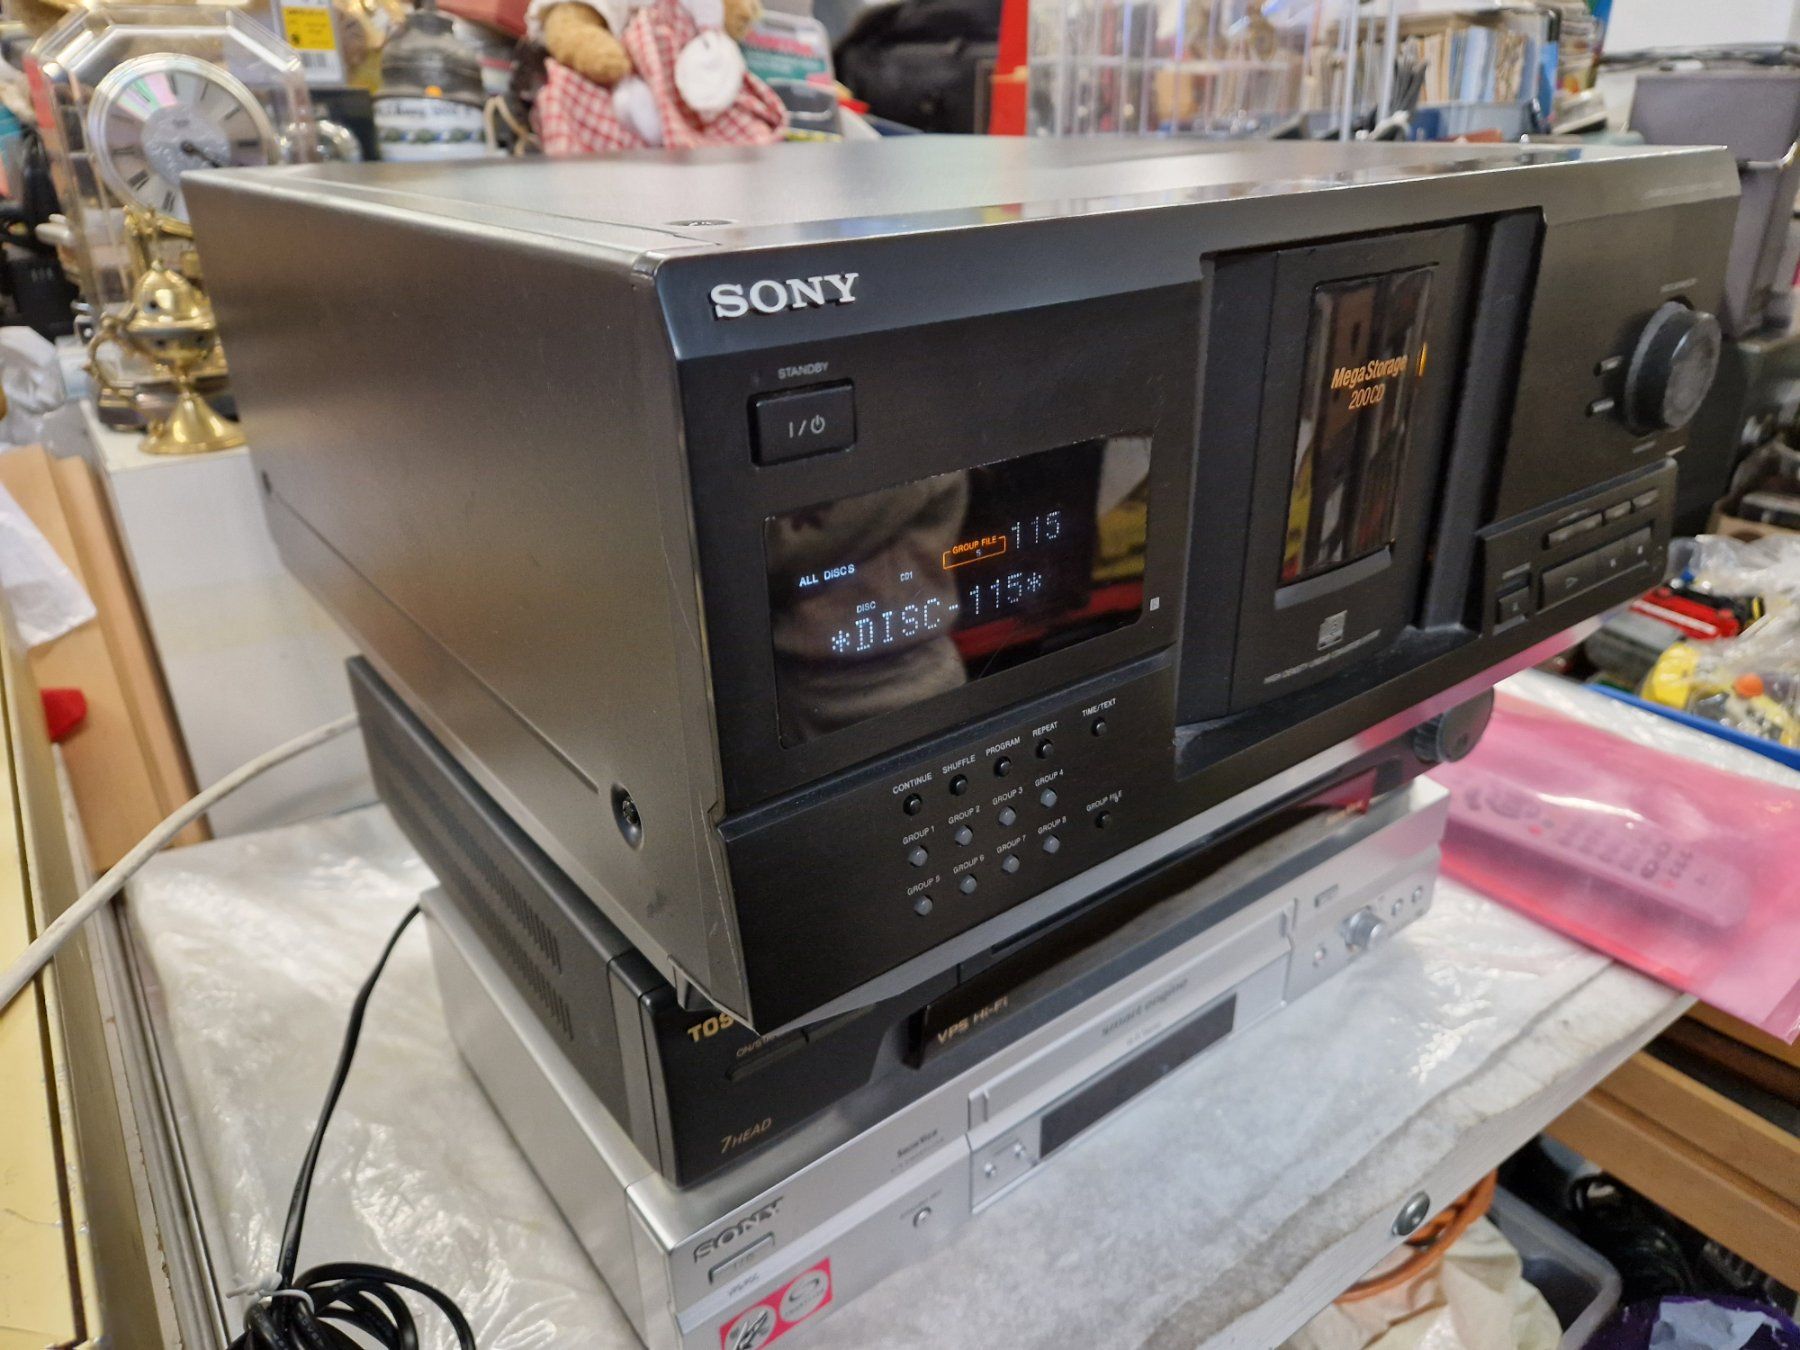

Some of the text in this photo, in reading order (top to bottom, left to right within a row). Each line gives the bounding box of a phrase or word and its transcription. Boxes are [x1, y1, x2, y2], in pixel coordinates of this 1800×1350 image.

[710, 272, 860, 319] SONY
[777, 361, 829, 380] STANDBY
[1330, 354, 1408, 390] MegaStorage
[1011, 510, 1061, 549] 115
[952, 534, 998, 554] GROUP FILE
[799, 563, 856, 588] ALL DISCS
[856, 600, 877, 614] DISC
[1081, 697, 1117, 717] TIME/TEXT
[1032, 720, 1059, 737] REPEAT
[985, 736, 1021, 757] PROGRAM
[942, 754, 976, 775] SHUFFLE
[892, 771, 933, 795] CONTINUE
[1035, 769, 1064, 787] GROUP 4
[992, 786, 1023, 806] GROUP 3
[1086, 795, 1109, 812] GROUP
[948, 804, 981, 825] GROUP 2
[1037, 818, 1061, 835] GROUP
[902, 828, 930, 846] GROUP
[996, 837, 1021, 854] GROUP
[953, 854, 985, 874] GROUP 6
[907, 878, 935, 896] GROUP
[937, 1016, 970, 1044] VPS
[693, 1196, 784, 1263] SONY
